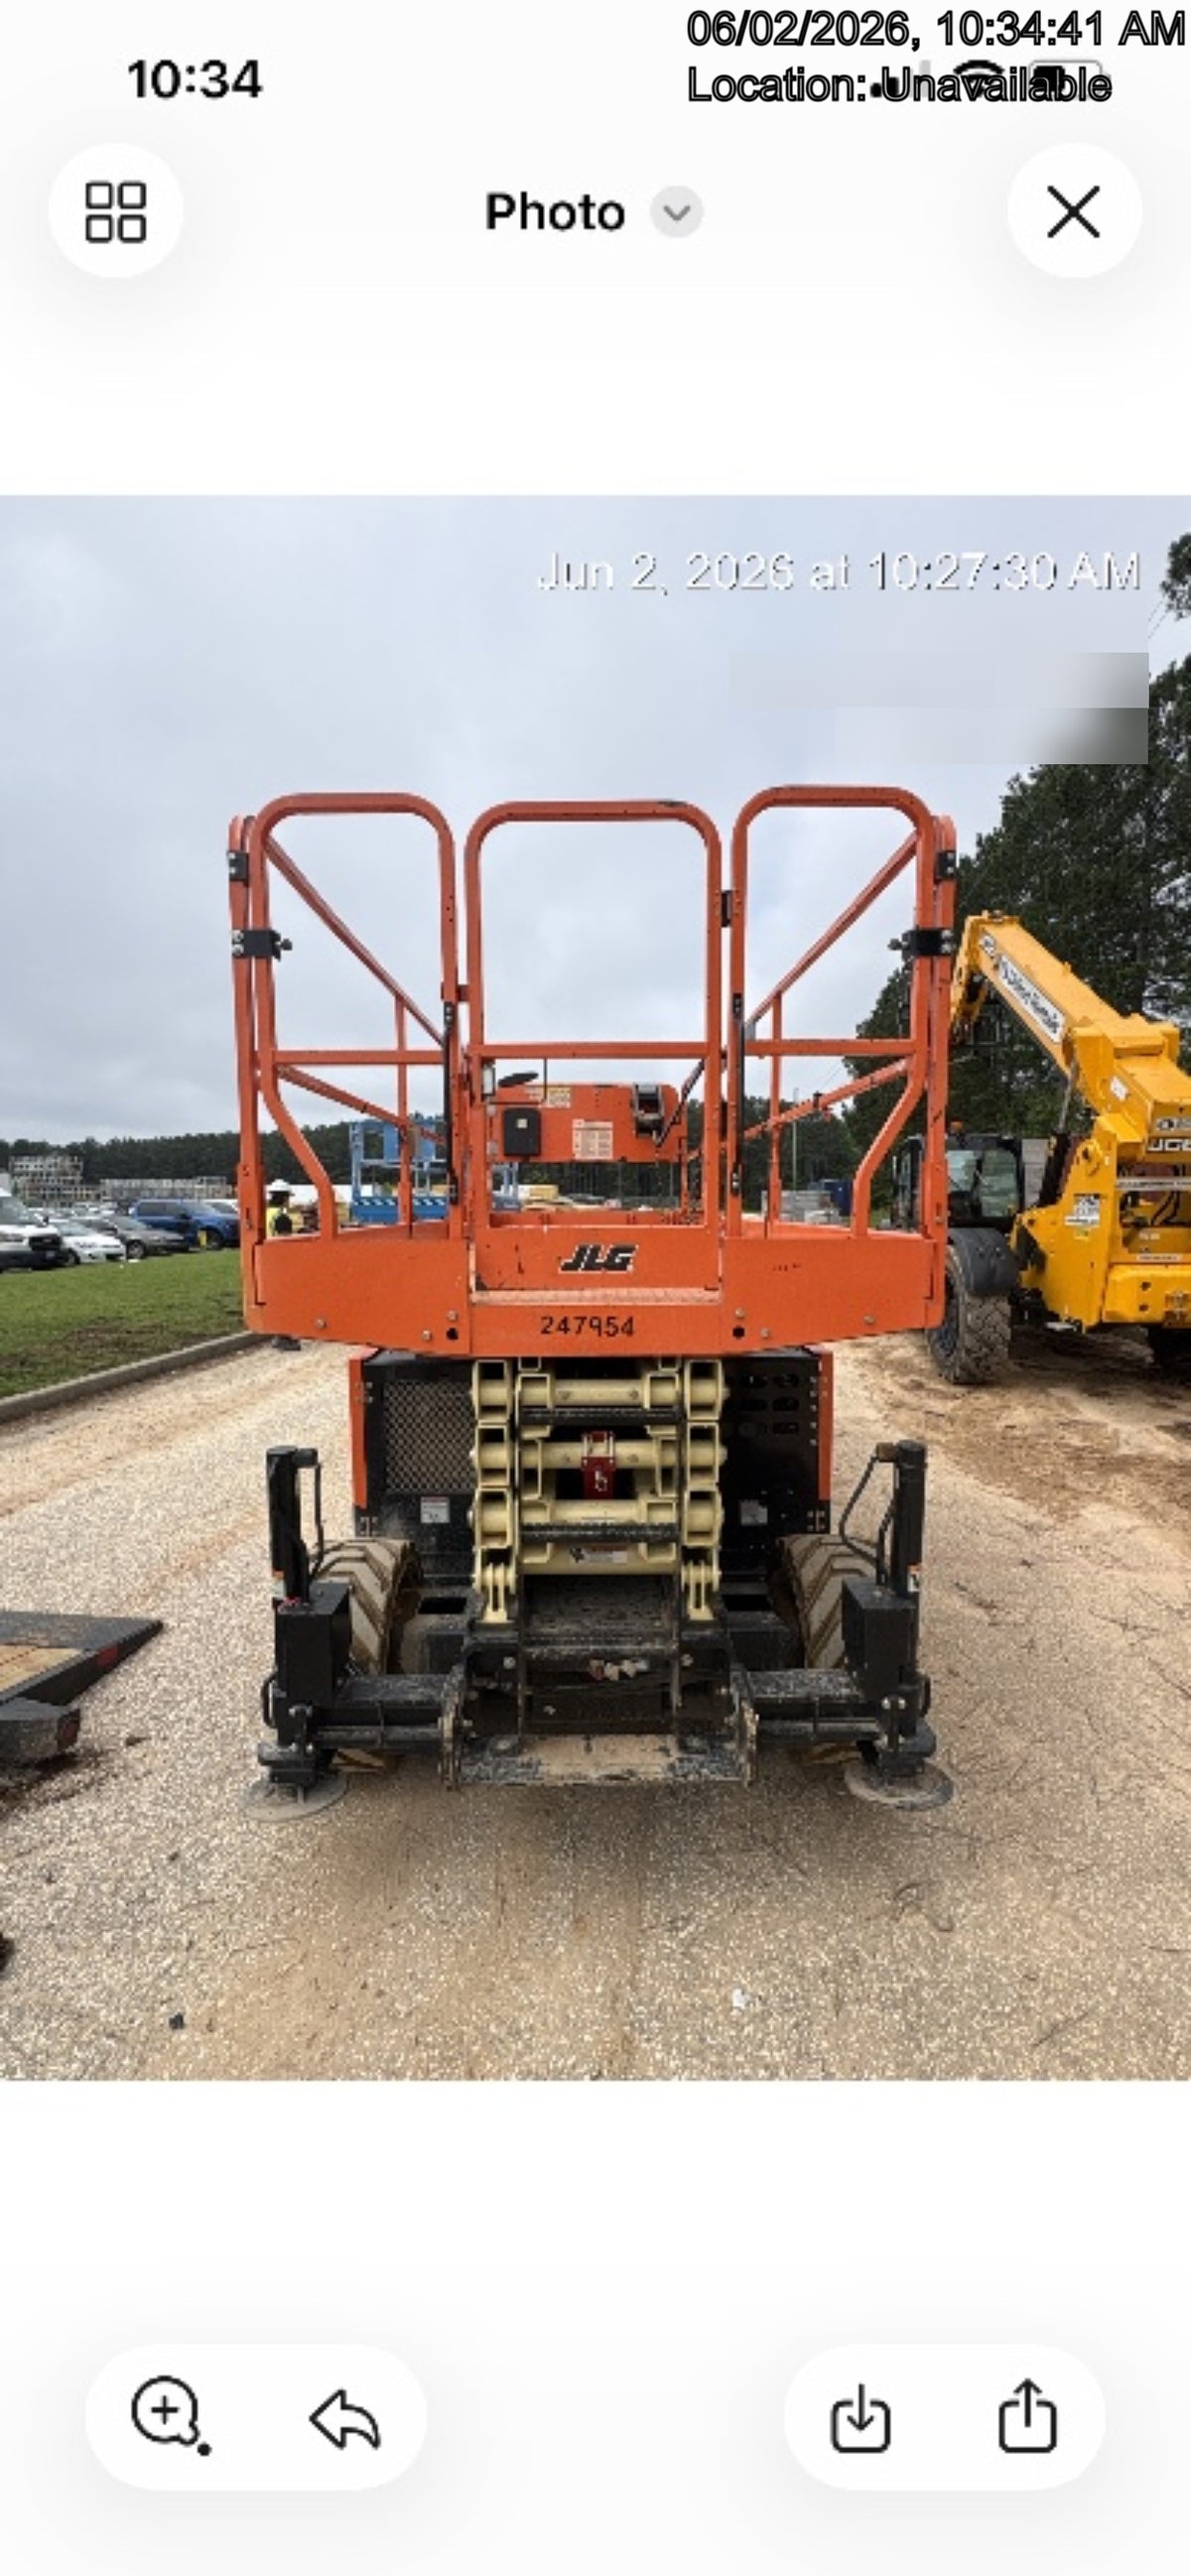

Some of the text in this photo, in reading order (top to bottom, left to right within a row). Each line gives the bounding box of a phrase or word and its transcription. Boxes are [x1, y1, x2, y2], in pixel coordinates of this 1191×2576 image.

[127, 59, 264, 99] 10:34
[485, 191, 626, 232] Photo
[558, 1243, 639, 1274] JLG
[540, 1315, 635, 1338] 247954
